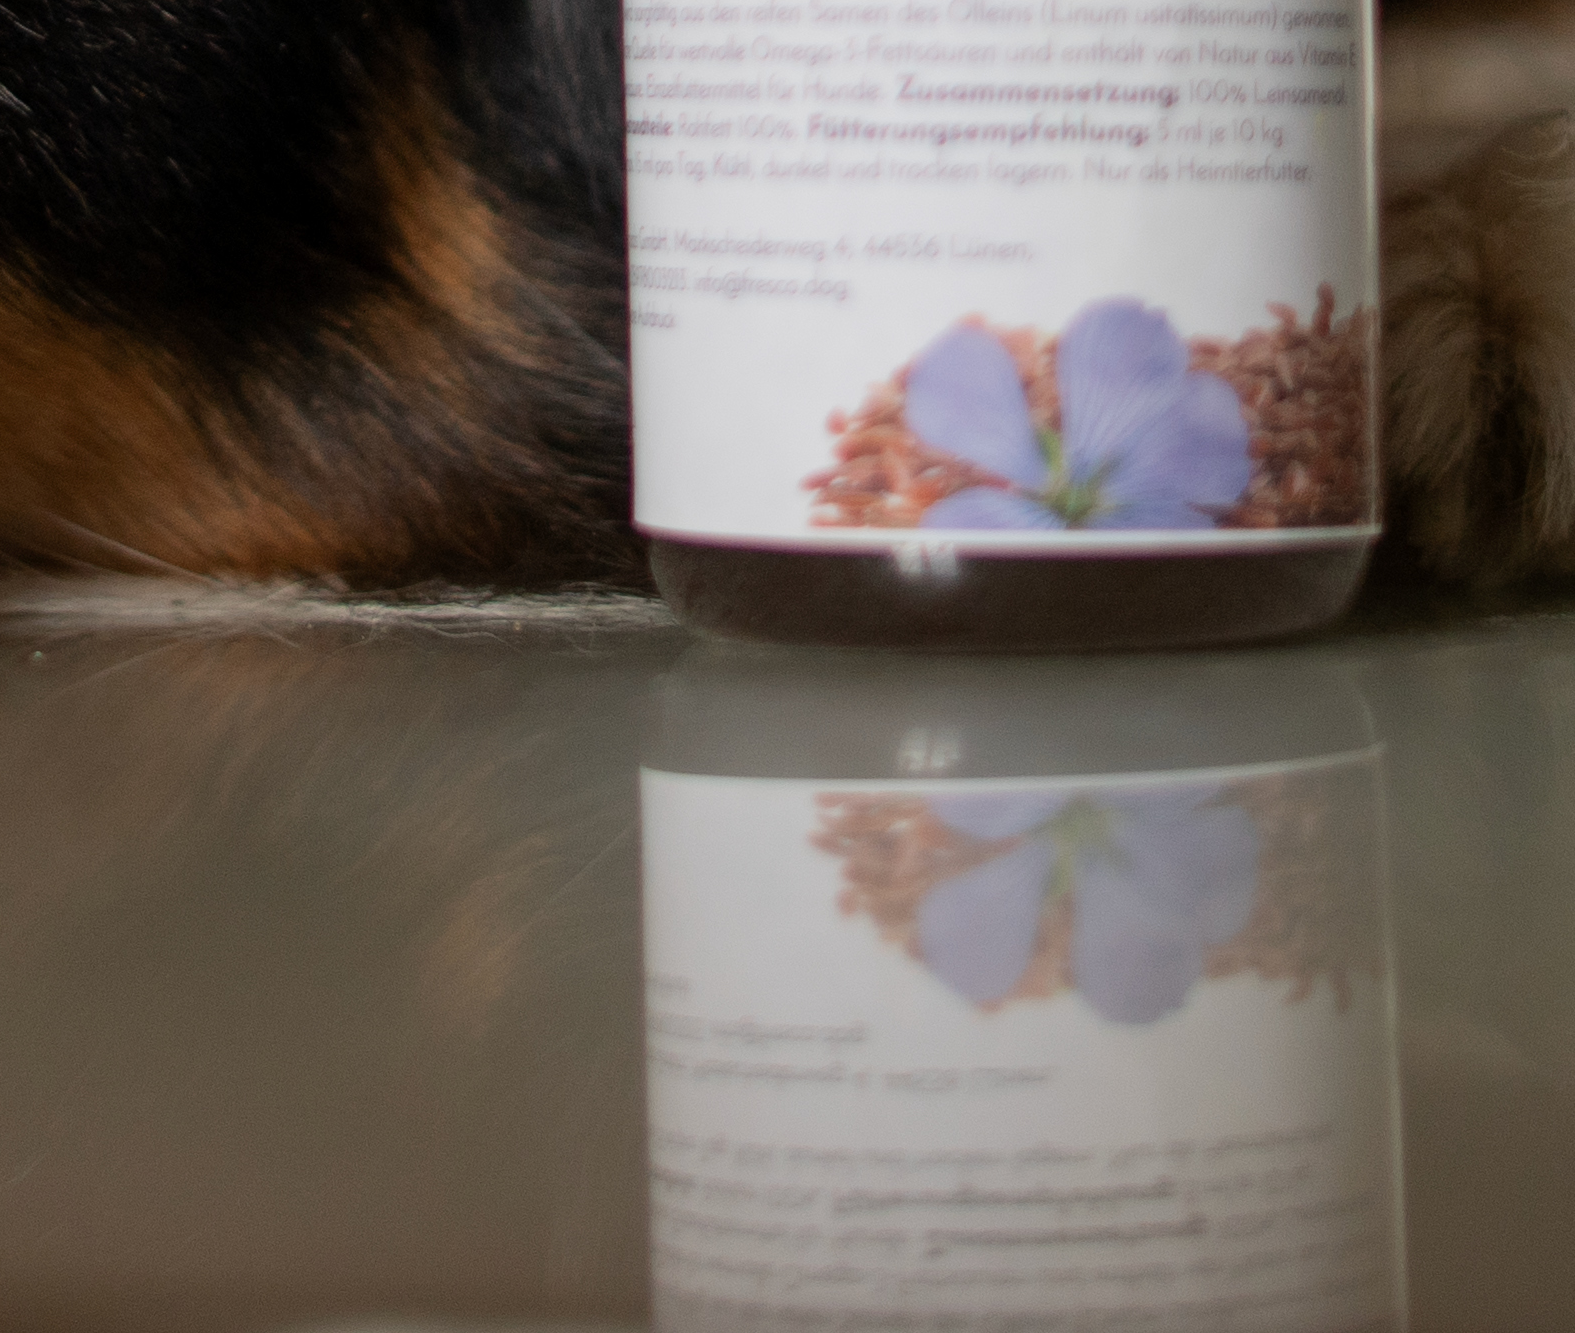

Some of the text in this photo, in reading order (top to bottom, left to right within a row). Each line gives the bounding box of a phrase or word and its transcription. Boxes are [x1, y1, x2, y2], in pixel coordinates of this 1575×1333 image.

[1005, 37, 1052, 63] und
[1061, 38, 1145, 65] enthält
[1153, 45, 1191, 65] von
[1197, 41, 1259, 67] Natur
[1265, 47, 1294, 67] aus
[896, 73, 1180, 108] Zusammensetzung:
[1187, 77, 1248, 104] 100%
[807, 112, 1149, 147] Fütterungsempfehlung:
[1174, 117, 1203, 143] ml
[1260, 117, 1285, 147] kg
[839, 152, 881, 180] und
[1082, 156, 1131, 182] Nur
[1139, 154, 1169, 182] als
